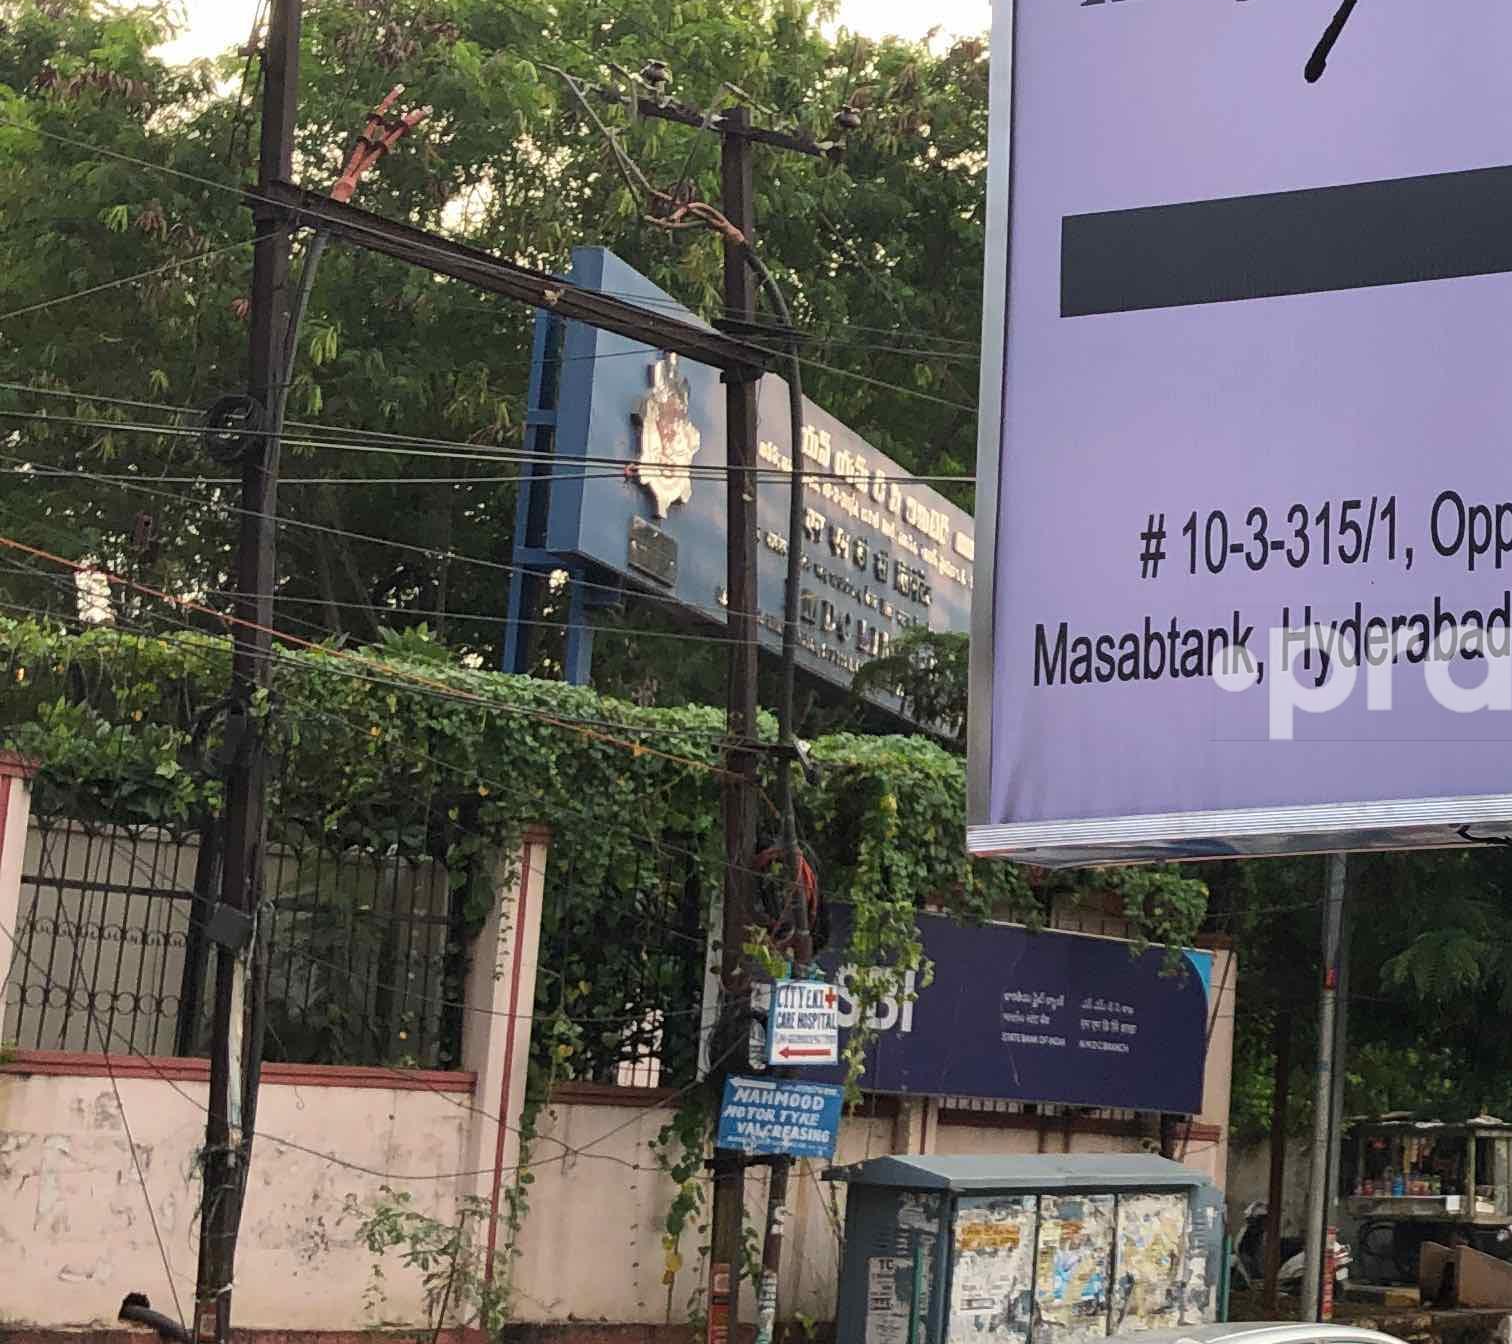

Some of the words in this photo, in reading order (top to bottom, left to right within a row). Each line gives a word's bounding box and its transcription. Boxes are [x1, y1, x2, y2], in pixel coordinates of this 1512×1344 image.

[1138, 513, 1168, 580] #
[1180, 494, 1416, 576] 10-3-315/1,
[1031, 609, 1264, 688] Masabtank,
[721, 1105, 776, 1121] MOTOR
[779, 1110, 821, 1126] TYRE
[733, 1088, 825, 1110] MAHMOOD
